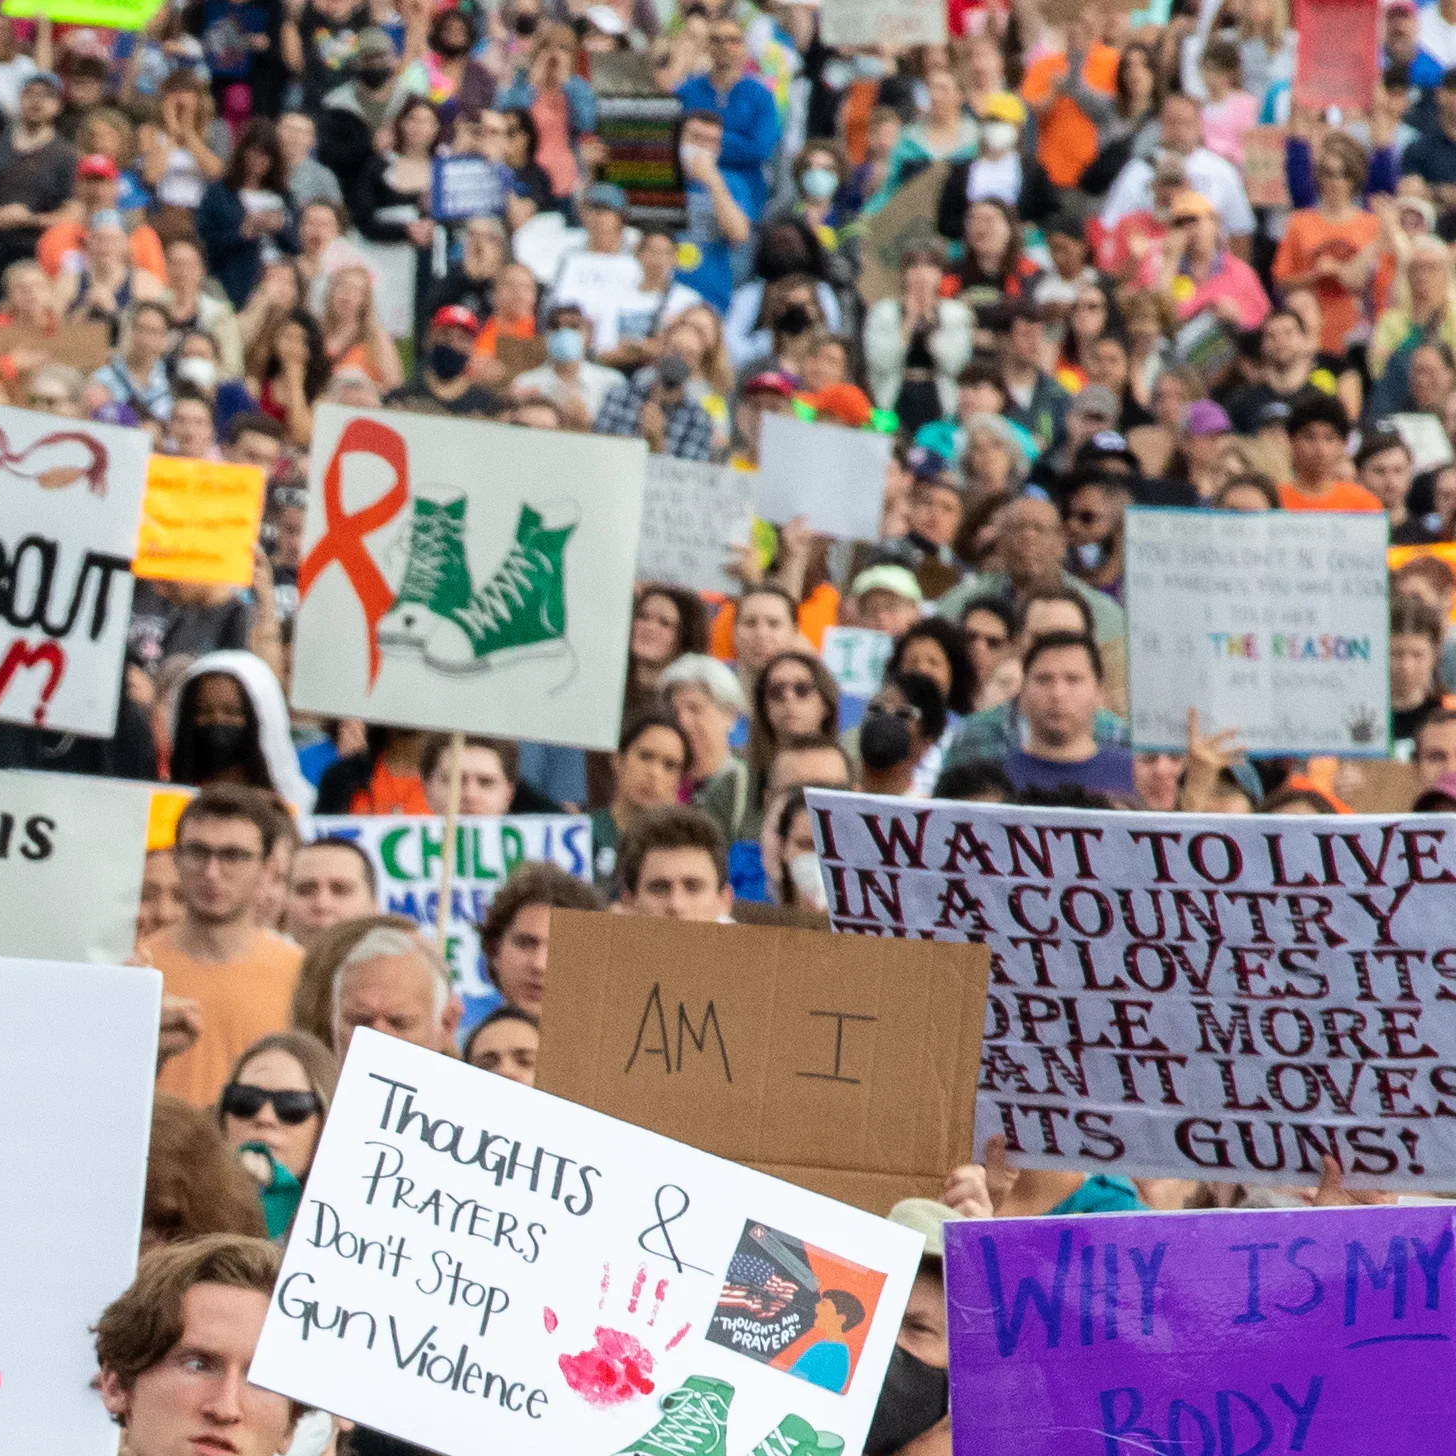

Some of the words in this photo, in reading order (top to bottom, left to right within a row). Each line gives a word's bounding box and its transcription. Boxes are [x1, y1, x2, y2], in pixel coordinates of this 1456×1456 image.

[1207, 631, 1261, 662] THE
[1270, 631, 1370, 664] REASON
[379, 823, 526, 881] CHILD
[542, 823, 585, 877] IS
[812, 808, 845, 862] I
[860, 808, 1104, 880] WANT
[1128, 828, 1244, 886] TO
[1263, 822, 1448, 888] LIVE
[830, 868, 904, 930] IN
[935, 877, 994, 932] A
[1007, 880, 1418, 948] COUNTRY
[1070, 932, 1331, 1003] LOVES
[624, 982, 733, 1084] AM
[795, 1008, 881, 1086] I
[1192, 1000, 1440, 1062] MORE
[1114, 1052, 1189, 1105] IT
[1214, 1058, 1456, 1122] LOVES
[995, 1100, 1126, 1163] ITS
[1173, 1114, 1426, 1180] GUNS!
[359, 1139, 547, 1266] PRAYERS
[638, 1183, 716, 1275] &
[308, 1198, 413, 1283] Don't
[415, 1250, 510, 1338] Stop
[978, 1228, 1170, 1359] WHY
[1229, 1236, 1326, 1325] IS
[1341, 1230, 1456, 1327] MY
[276, 1271, 382, 1354] Gun
[388, 1313, 550, 1424] Violence
[781, 1312, 800, 1328] AND
